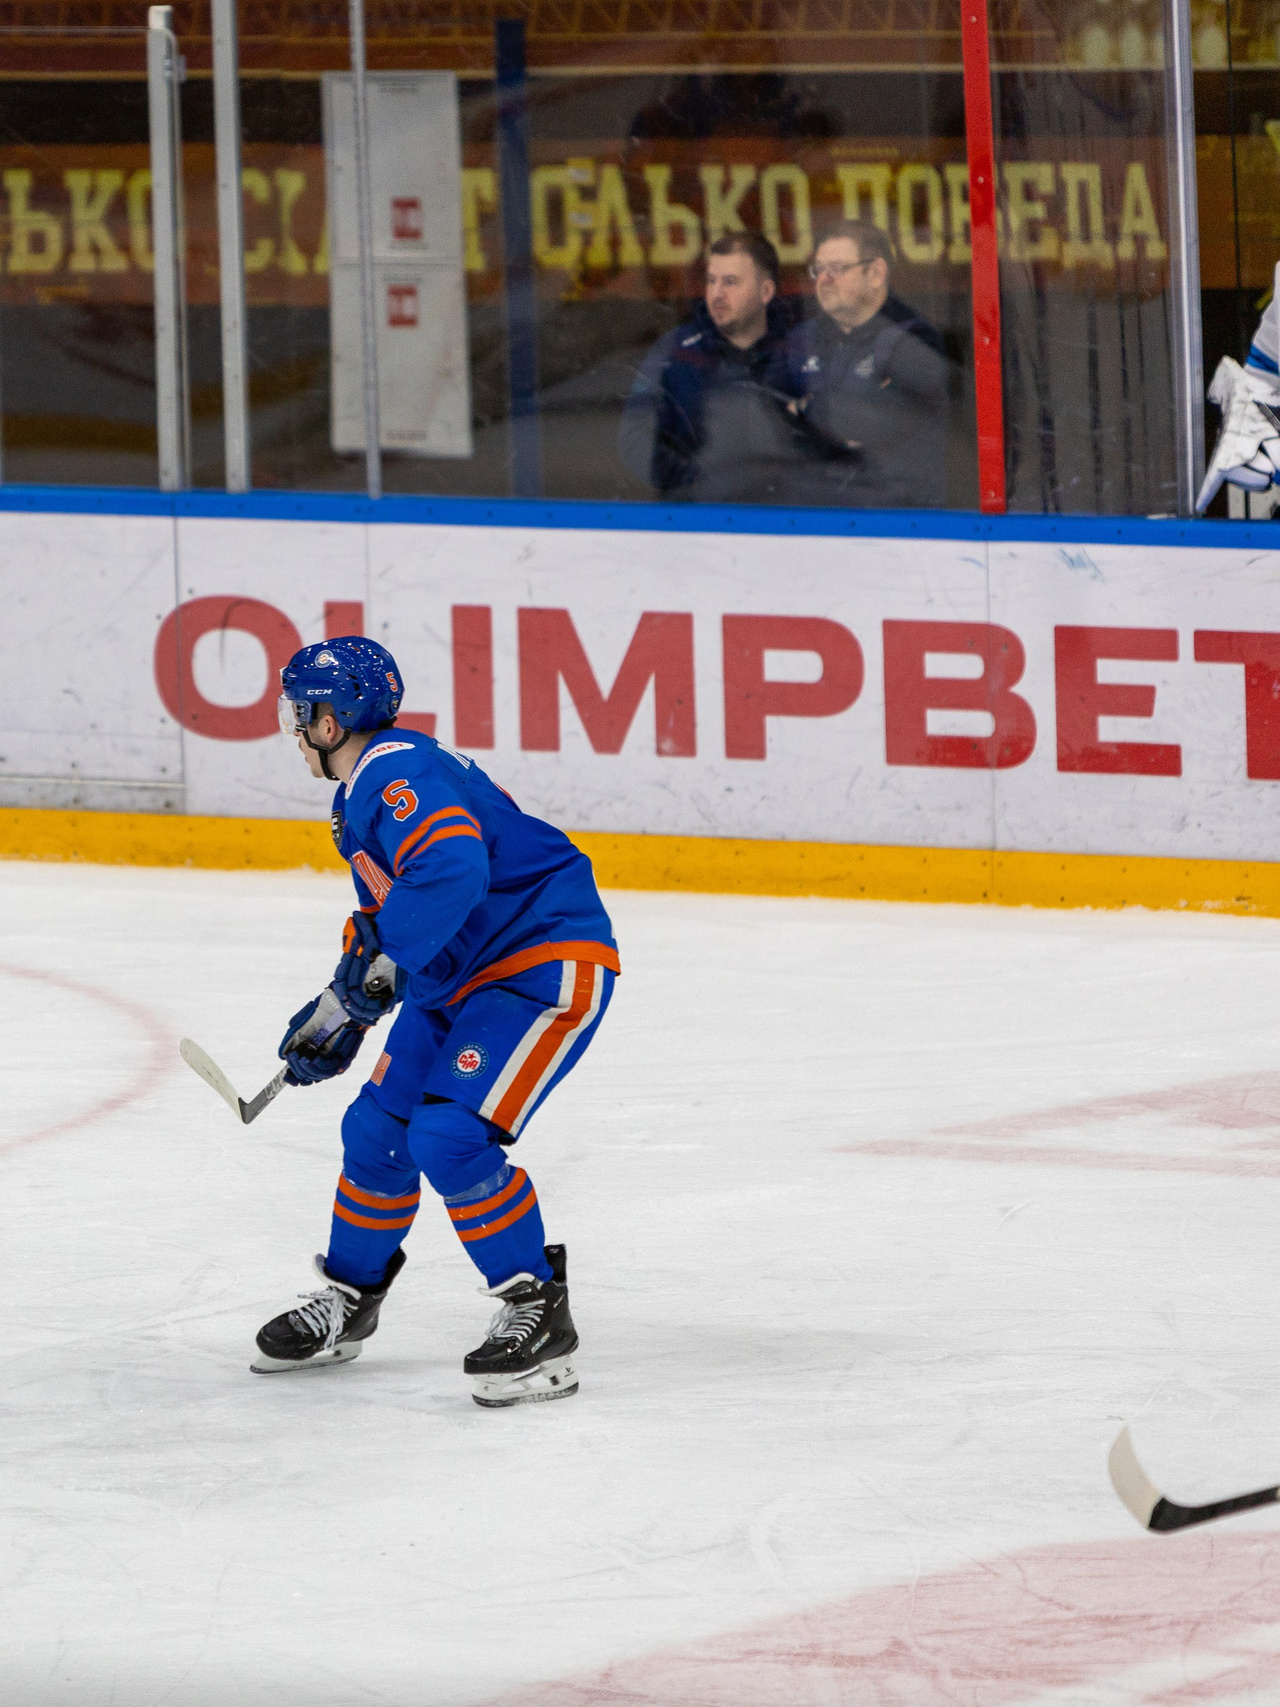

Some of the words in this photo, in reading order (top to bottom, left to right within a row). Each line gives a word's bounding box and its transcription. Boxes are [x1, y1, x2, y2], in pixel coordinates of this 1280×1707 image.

[306, 688, 333, 696] CCM
[385, 671, 399, 693] 5
[381, 778, 420, 822] 5
